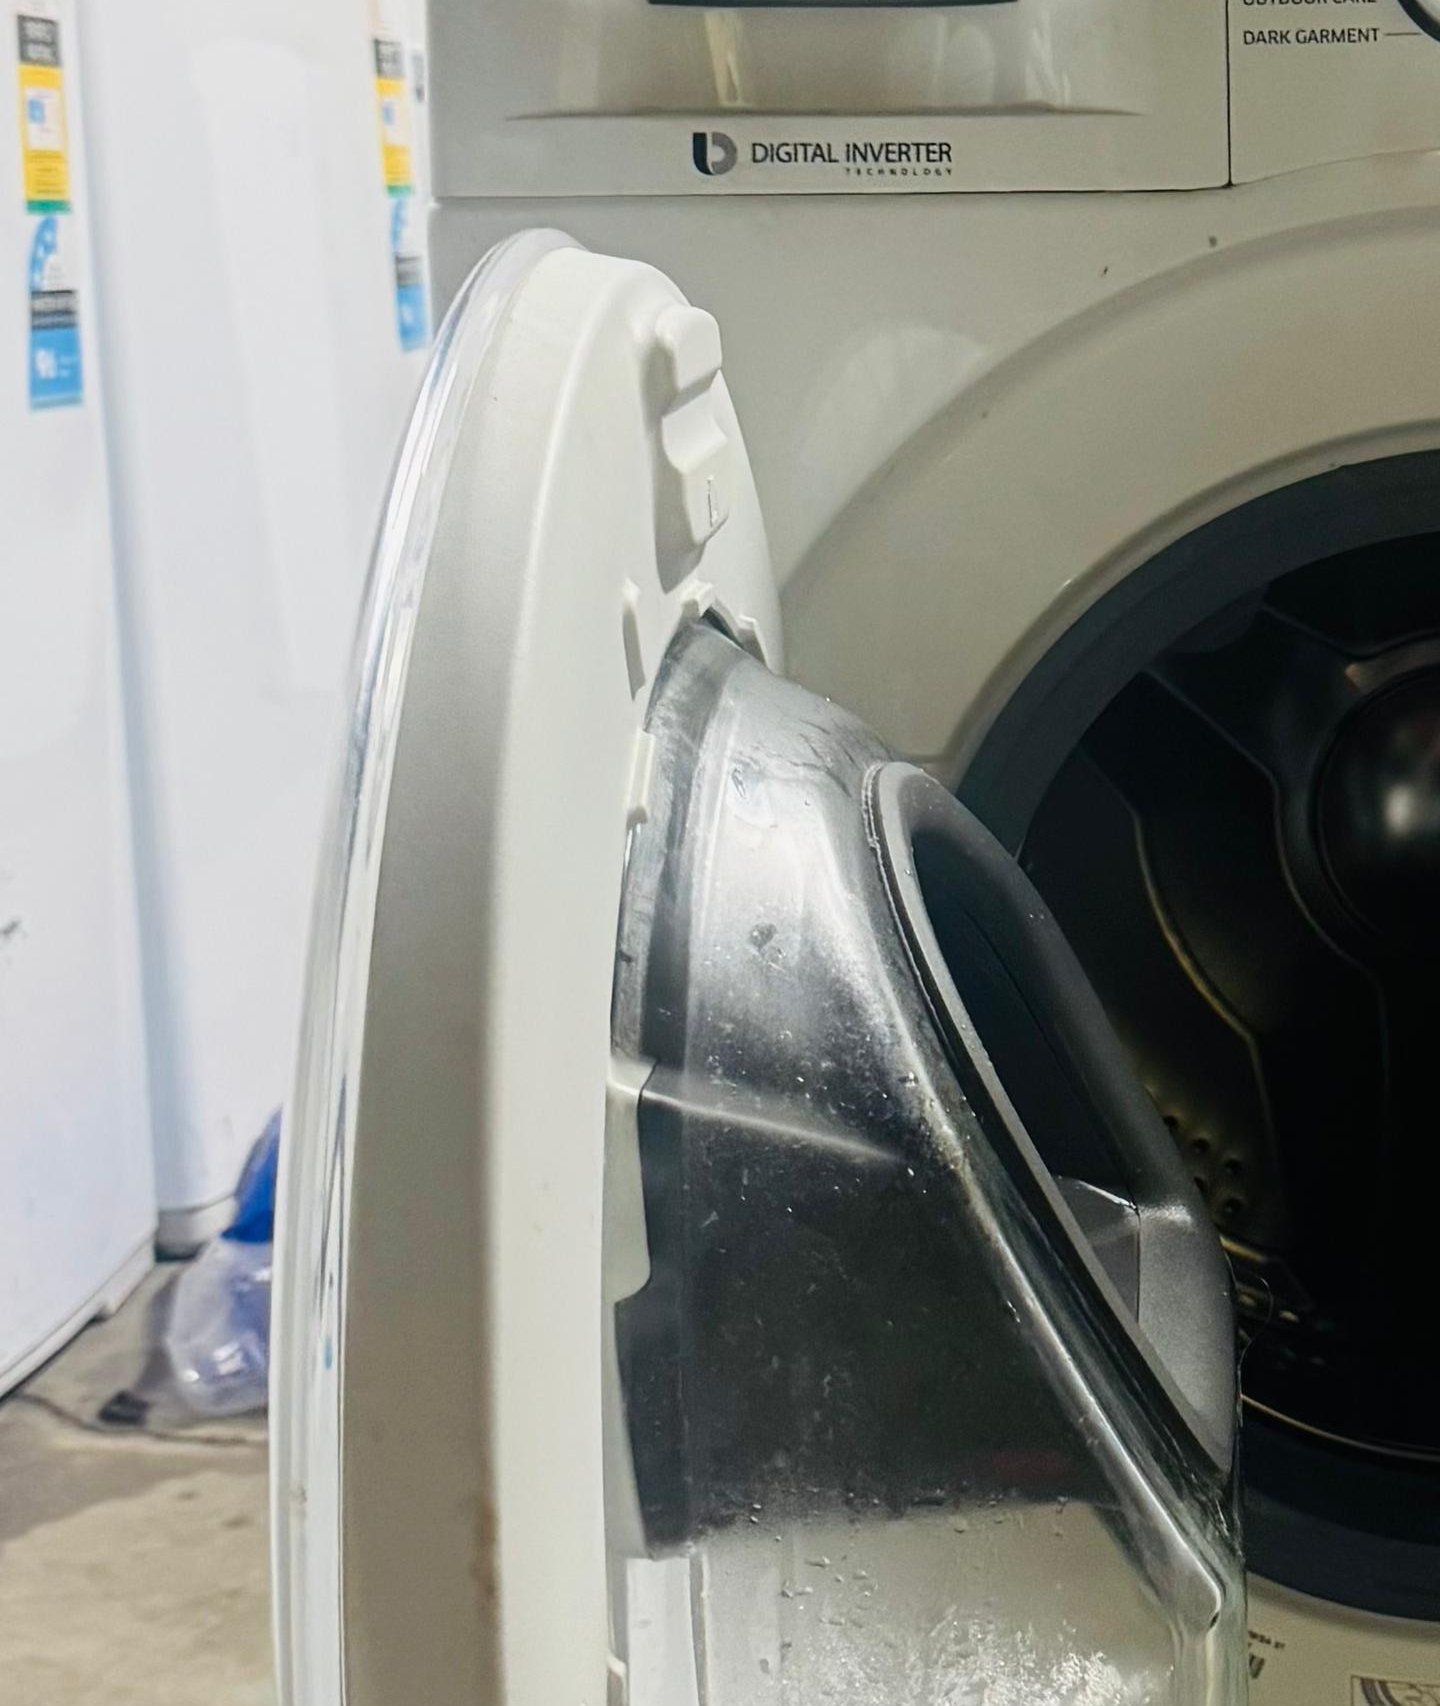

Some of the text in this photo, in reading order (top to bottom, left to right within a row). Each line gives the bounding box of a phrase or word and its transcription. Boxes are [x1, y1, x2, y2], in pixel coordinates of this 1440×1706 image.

[1243, 27, 1379, 46] DARK GARMENT
[751, 142, 952, 164] DIGITAL INVERTER
[845, 167, 952, 177] TECHNOLOGY
